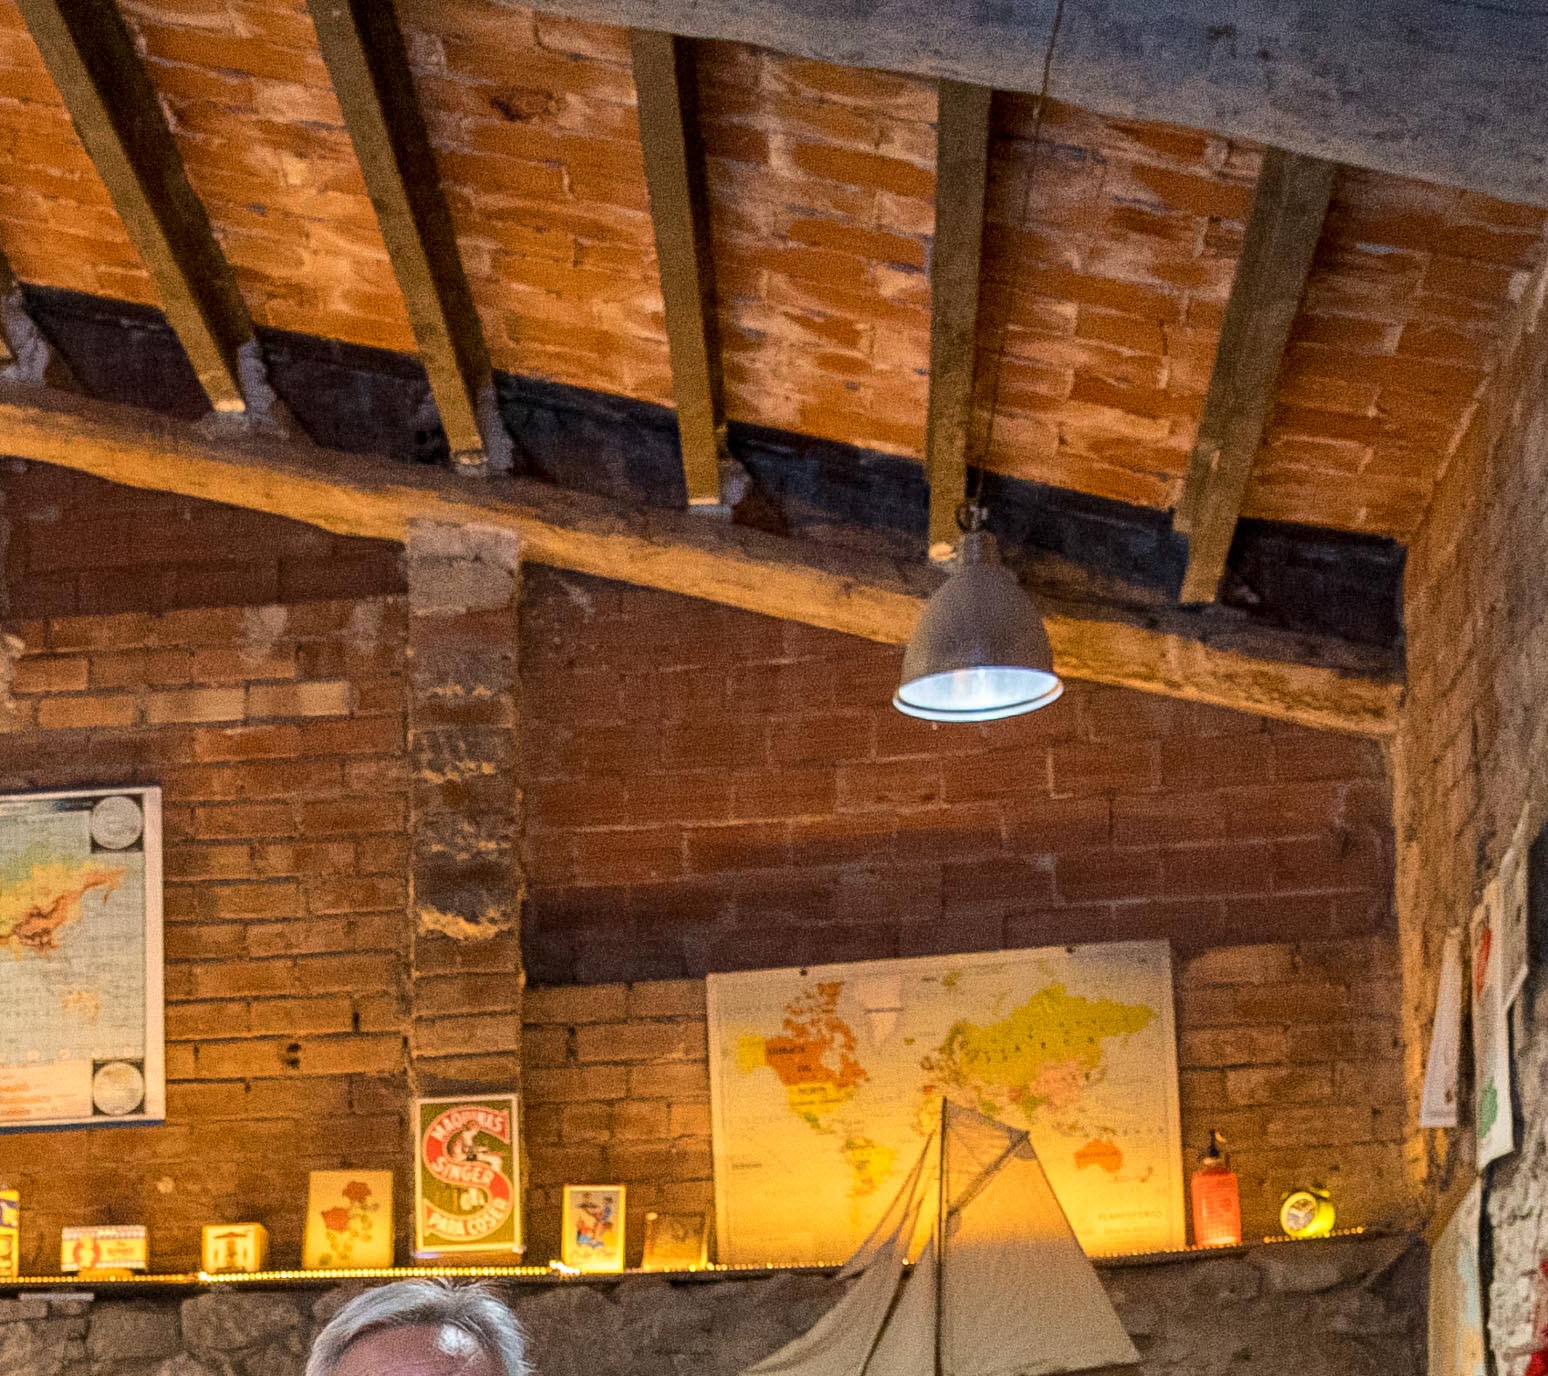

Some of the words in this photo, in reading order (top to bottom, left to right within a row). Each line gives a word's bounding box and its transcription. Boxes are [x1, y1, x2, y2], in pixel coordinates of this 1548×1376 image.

[432, 1156, 495, 1183] SINGER
[429, 1211, 465, 1233] PARA
[468, 1198, 507, 1235] COSER
